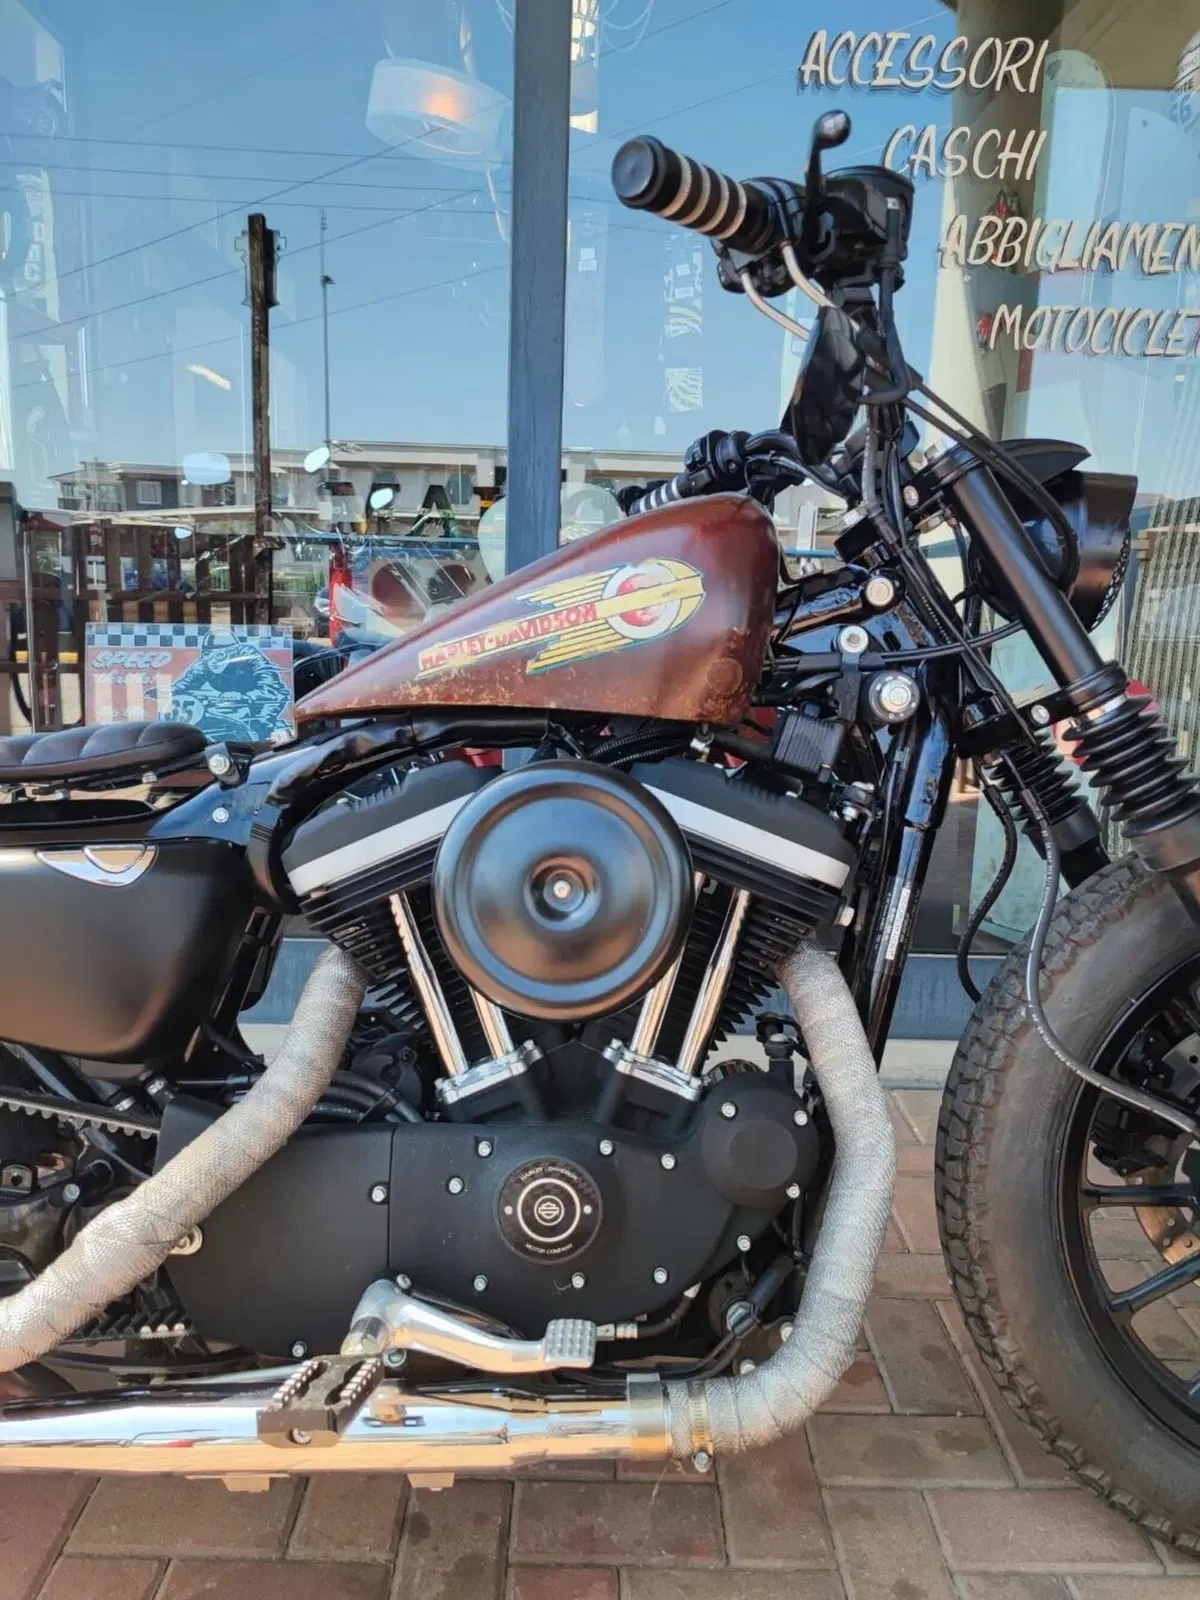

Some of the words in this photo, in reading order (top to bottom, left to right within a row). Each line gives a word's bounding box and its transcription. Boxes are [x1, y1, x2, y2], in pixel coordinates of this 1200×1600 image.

[800, 29, 1048, 93] ACCESSORI
[884, 123, 1047, 180] CASCHI
[91, 650, 173, 669] SPEED
